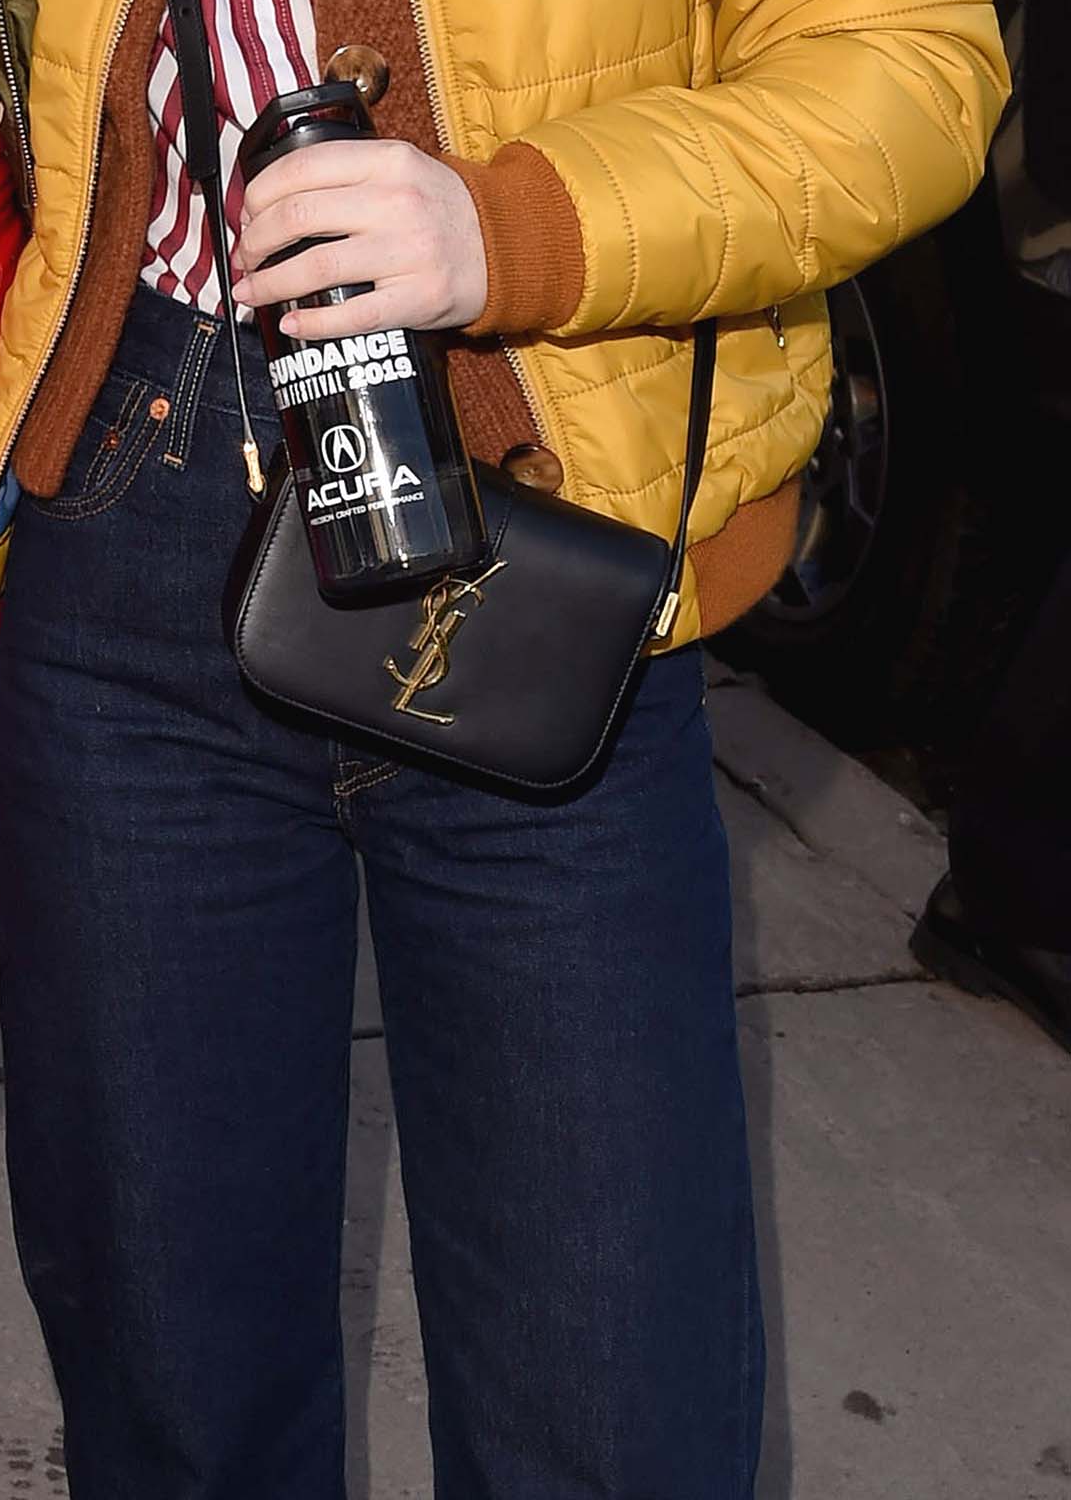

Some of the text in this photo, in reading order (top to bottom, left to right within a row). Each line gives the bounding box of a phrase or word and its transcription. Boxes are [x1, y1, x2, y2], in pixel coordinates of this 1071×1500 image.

[269, 329, 408, 388] SUNDANCE
[289, 370, 345, 406] FESTIVAL
[347, 356, 417, 390] 2019.
[308, 464, 422, 512] ACURA
[335, 505, 367, 520] CRAFTED
[368, 491, 425, 512] PERRMANCE
